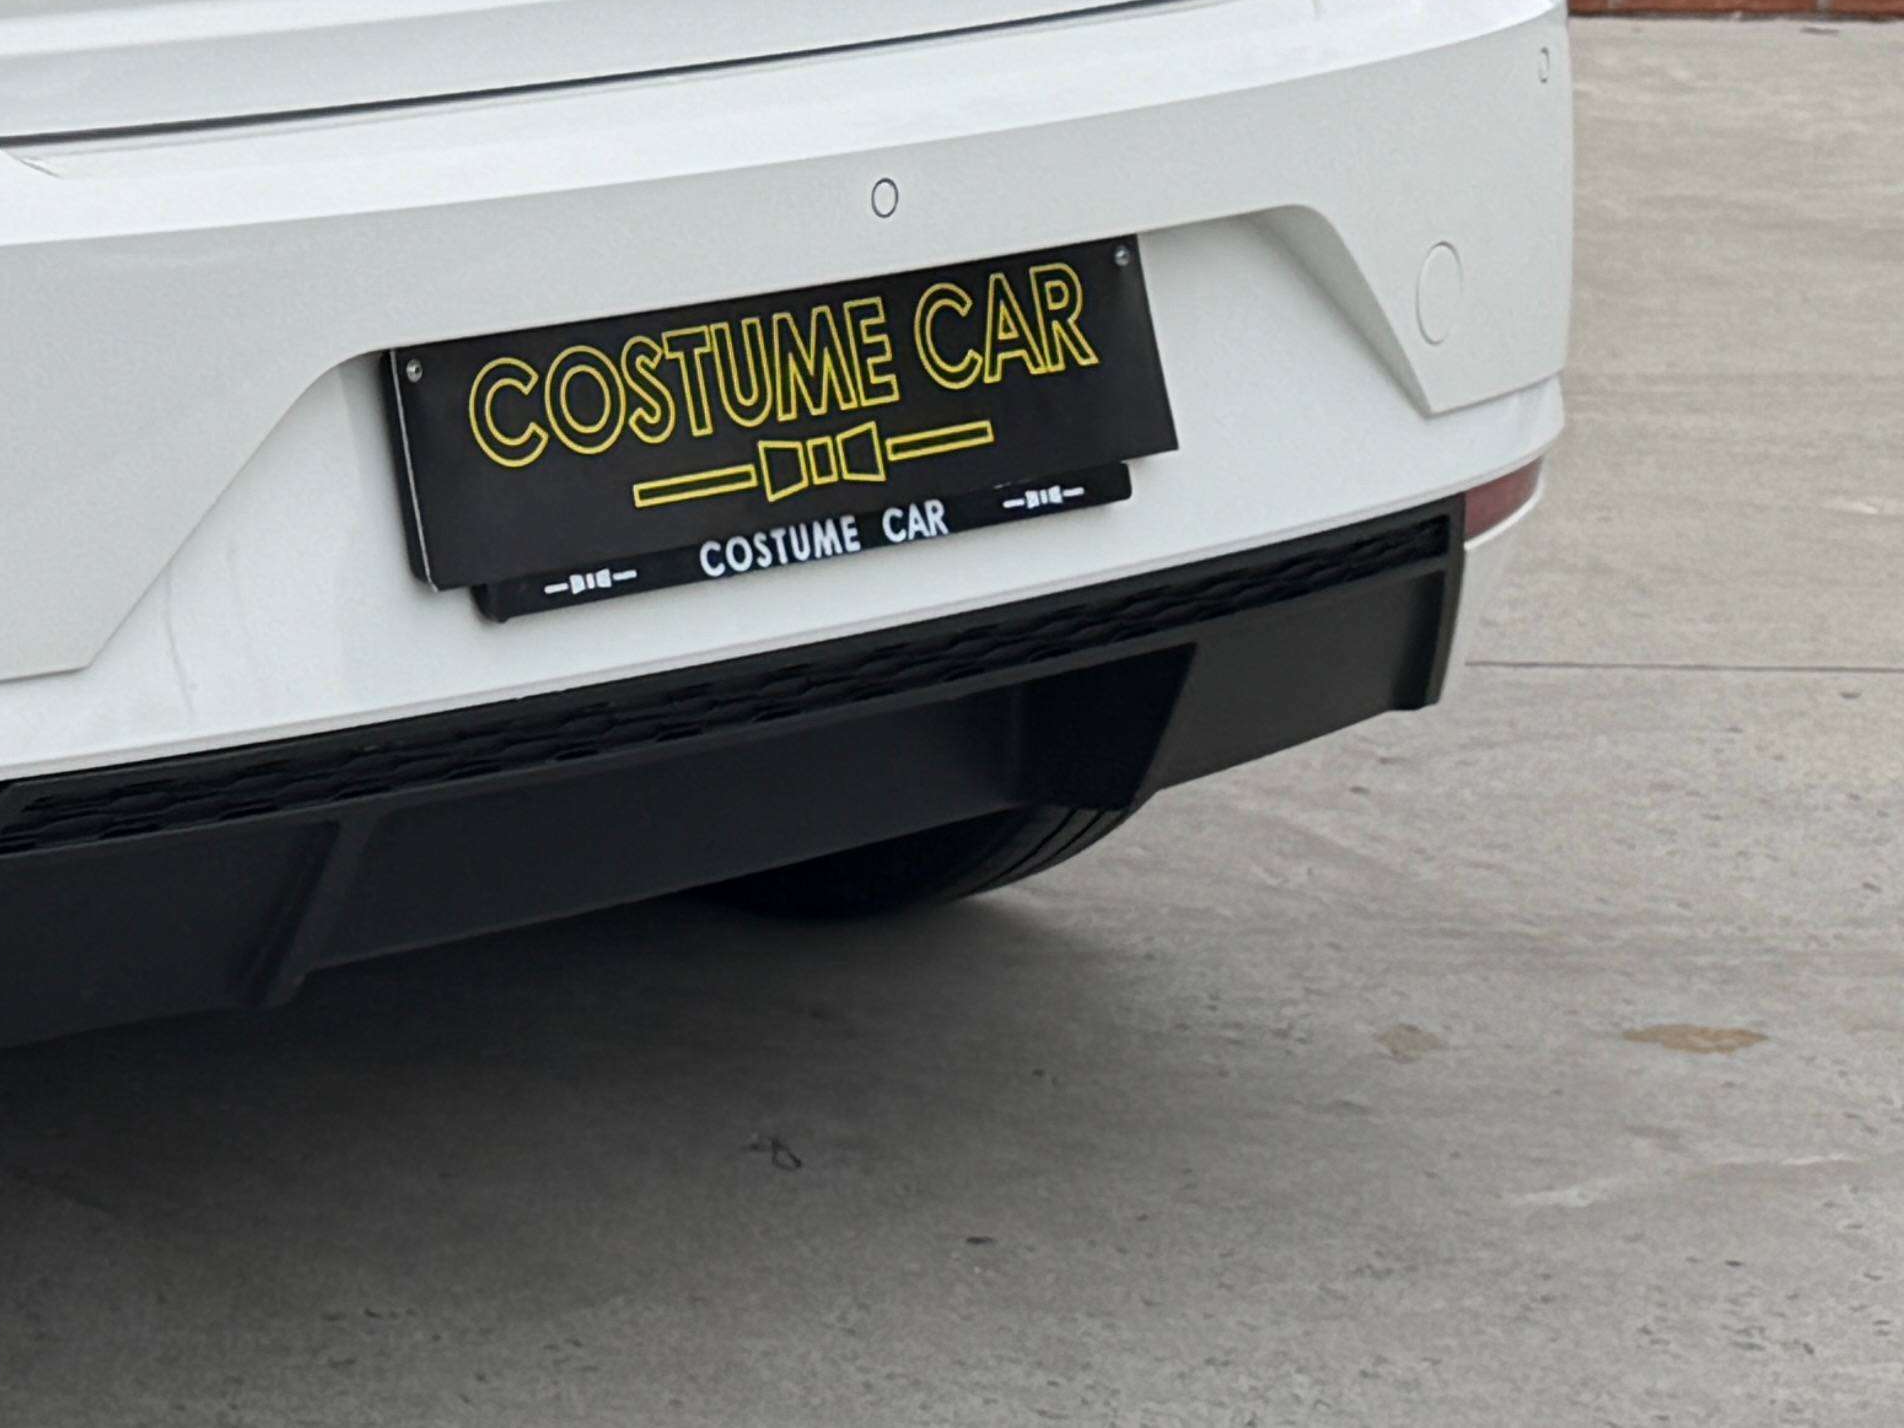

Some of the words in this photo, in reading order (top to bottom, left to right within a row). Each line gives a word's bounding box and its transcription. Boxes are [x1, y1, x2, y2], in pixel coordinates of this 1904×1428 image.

[467, 295, 900, 468] COSTUME
[913, 261, 1100, 391] CAR
[698, 514, 862, 580] COSTUME
[881, 498, 950, 544] CAR
